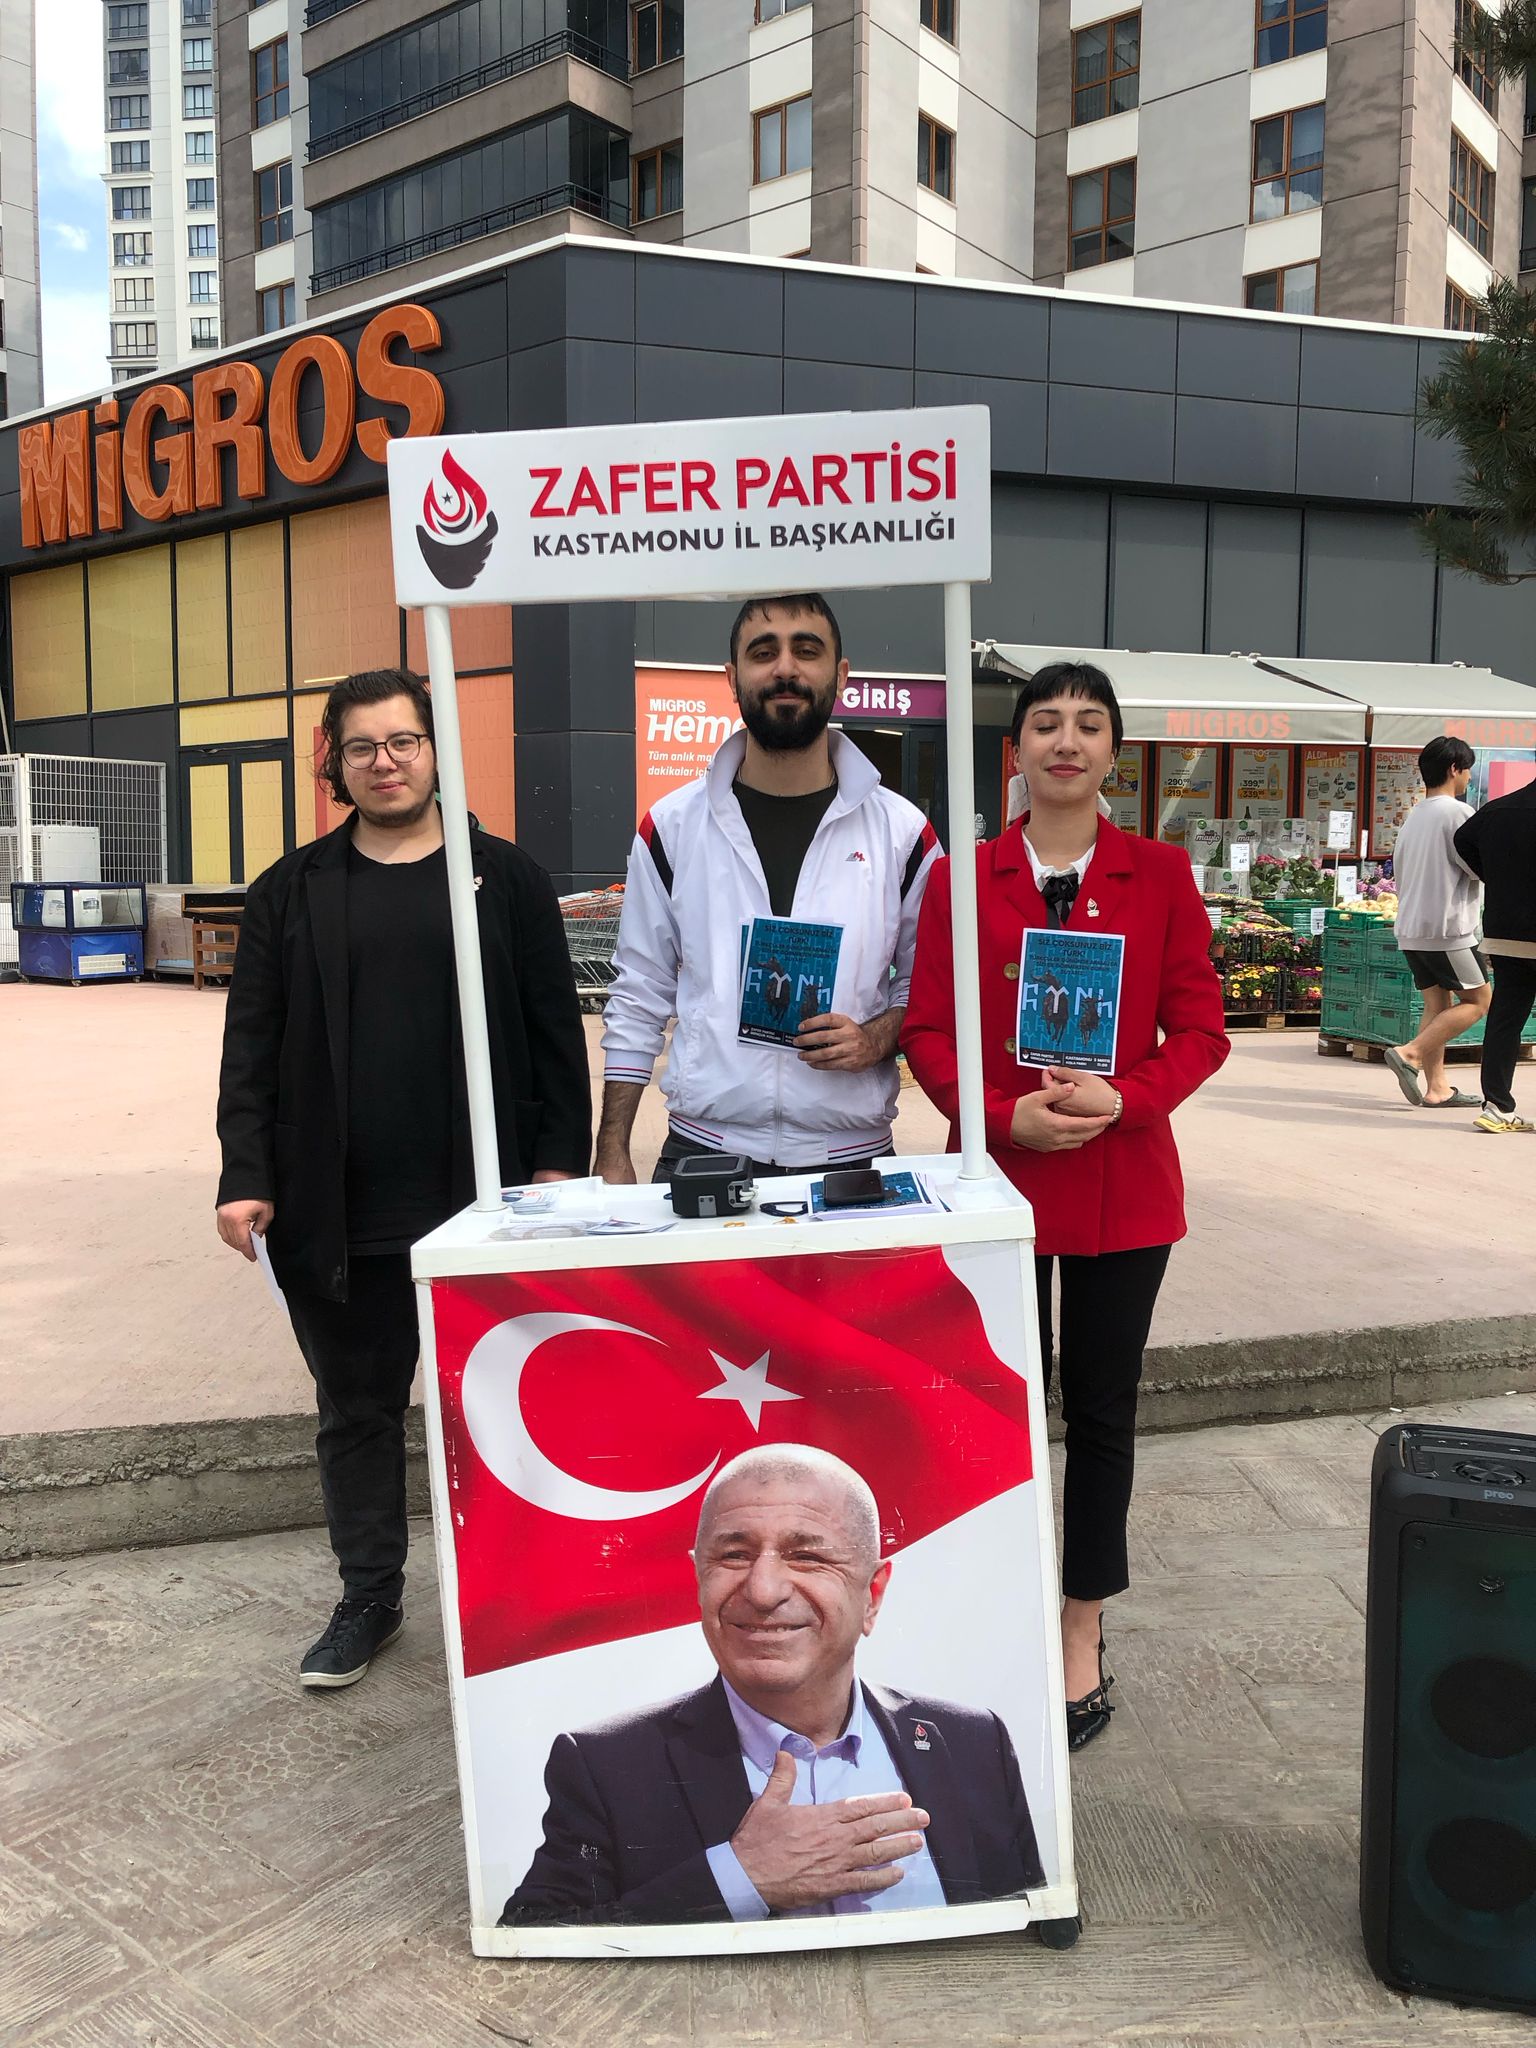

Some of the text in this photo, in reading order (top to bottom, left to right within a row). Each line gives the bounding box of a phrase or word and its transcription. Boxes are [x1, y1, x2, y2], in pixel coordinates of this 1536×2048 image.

[529, 439, 957, 518] ZAFER PARTİSİ
[533, 510, 955, 557] KASTAMONU İL BAŞKANLIĞI
[842, 682, 912, 715] GİRİŞ
[644, 713, 748, 744] Hem
[648, 750, 669, 761] Tüm
[671, 751, 695, 762] anlık
[648, 766, 694, 777] dakikalar
[1483, 1489, 1514, 1500] preo
